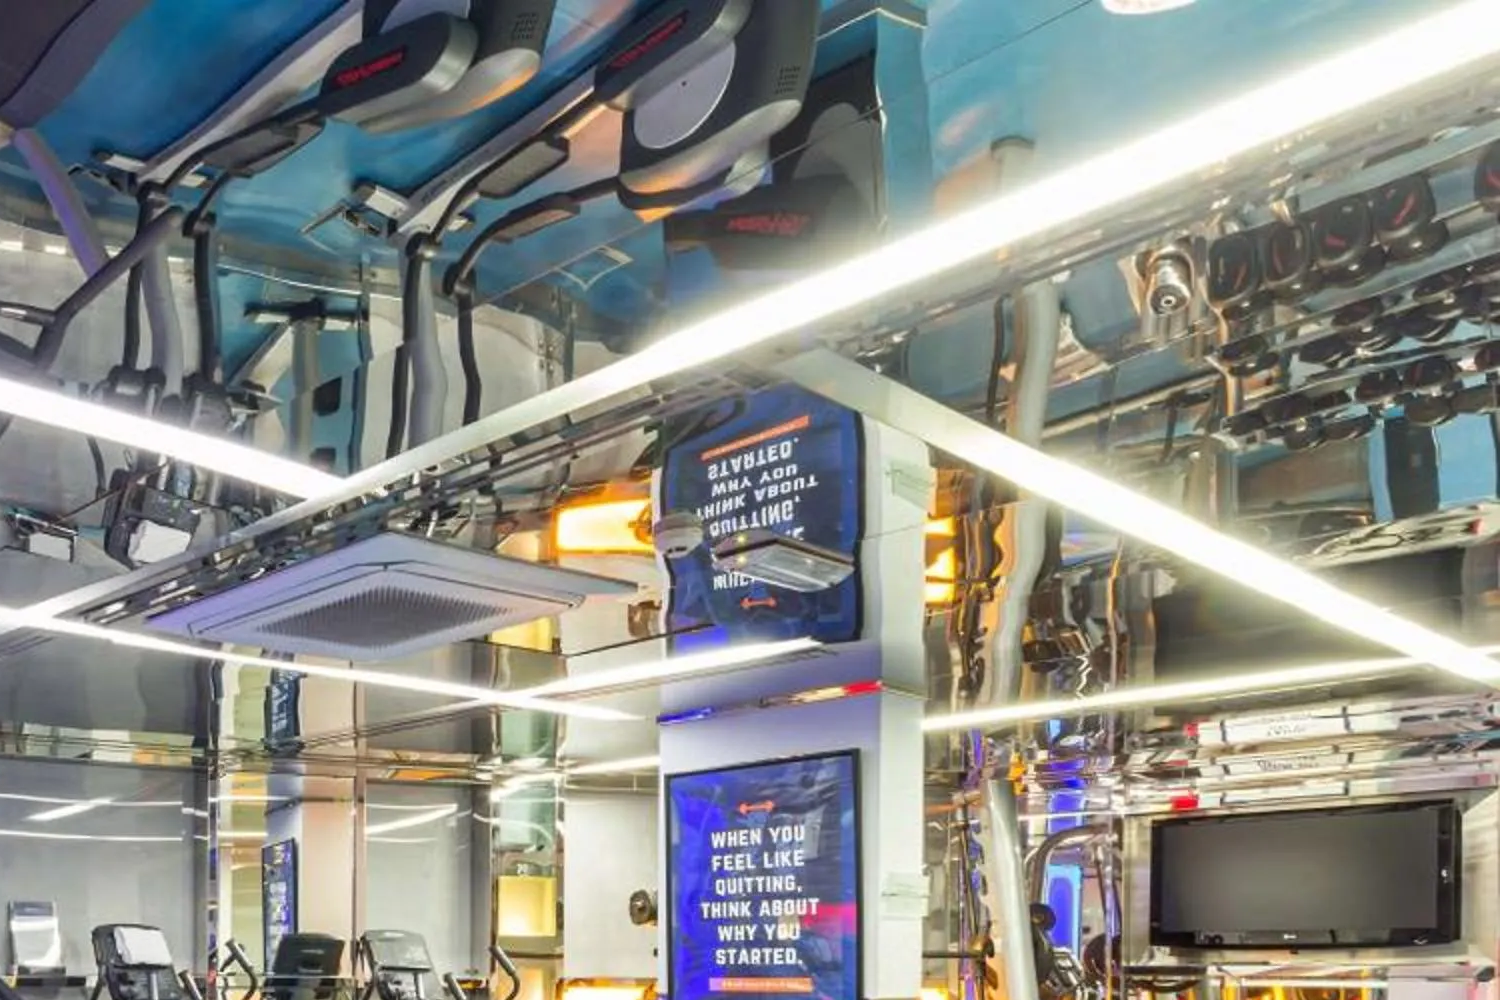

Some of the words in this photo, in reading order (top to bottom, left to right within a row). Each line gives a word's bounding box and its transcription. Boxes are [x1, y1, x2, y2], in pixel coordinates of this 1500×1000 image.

[711, 828, 762, 849] WHEN
[768, 825, 805, 843] YOU
[712, 854, 756, 872] FEEL
[763, 850, 805, 868] LIKE
[701, 901, 752, 919] THINK
[760, 898, 820, 916] ABOUT
[717, 924, 757, 942] WHY
[764, 922, 800, 940] YOU
[715, 947, 803, 966] STARTED.
